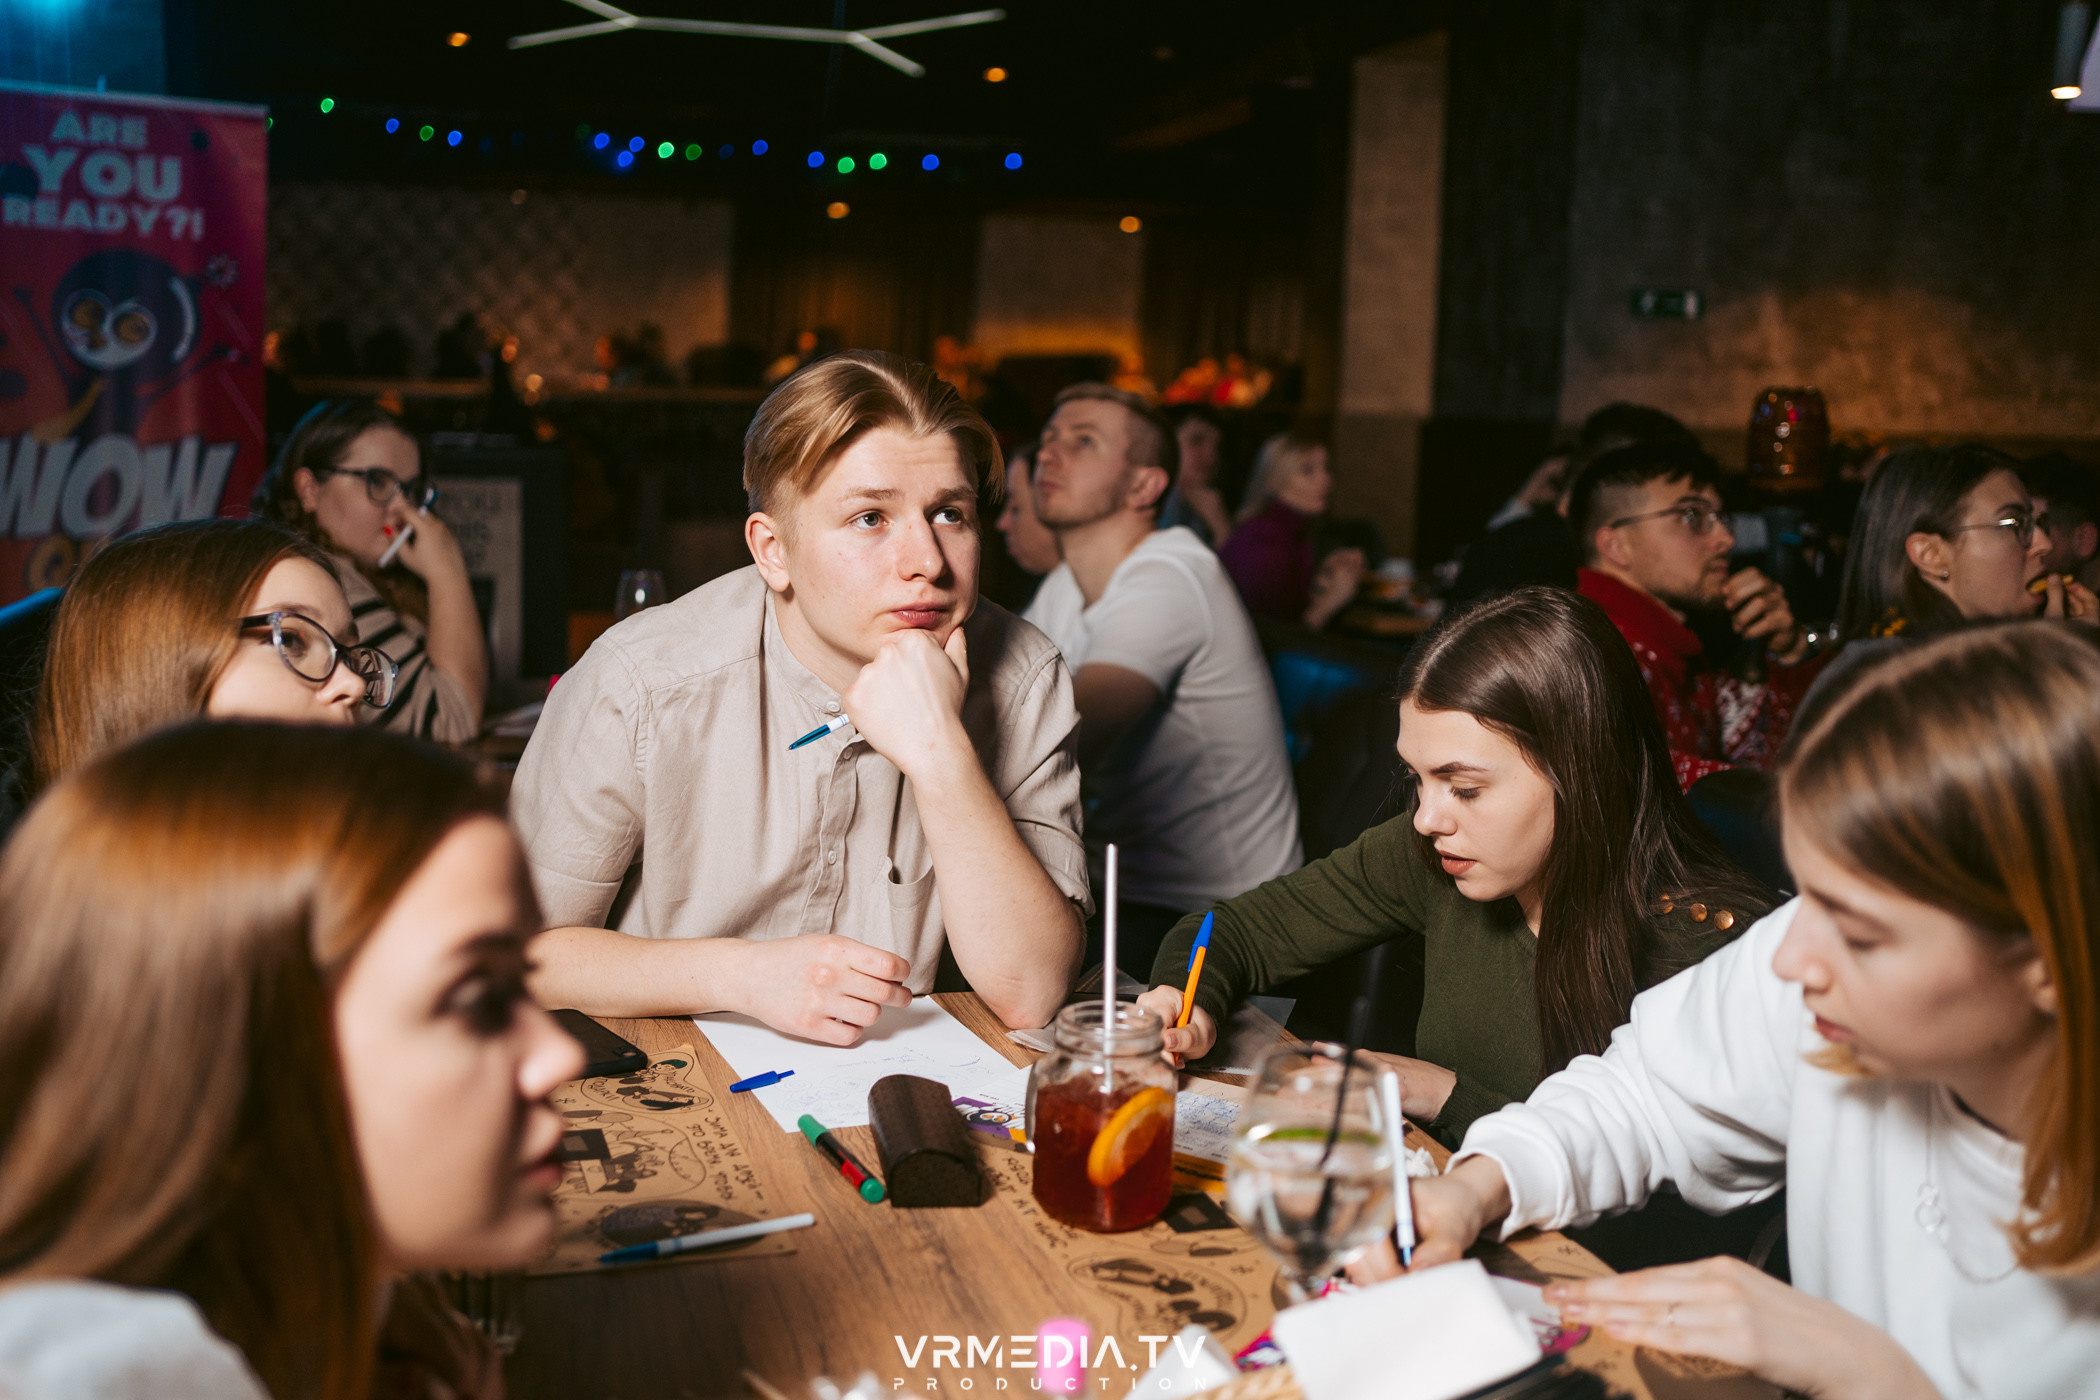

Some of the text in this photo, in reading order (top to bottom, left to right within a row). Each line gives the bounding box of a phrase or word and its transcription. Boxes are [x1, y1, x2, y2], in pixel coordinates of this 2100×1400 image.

[52, 110, 148, 149] ARE
[22, 143, 183, 201] YOU
[0, 432, 241, 540] WOW
